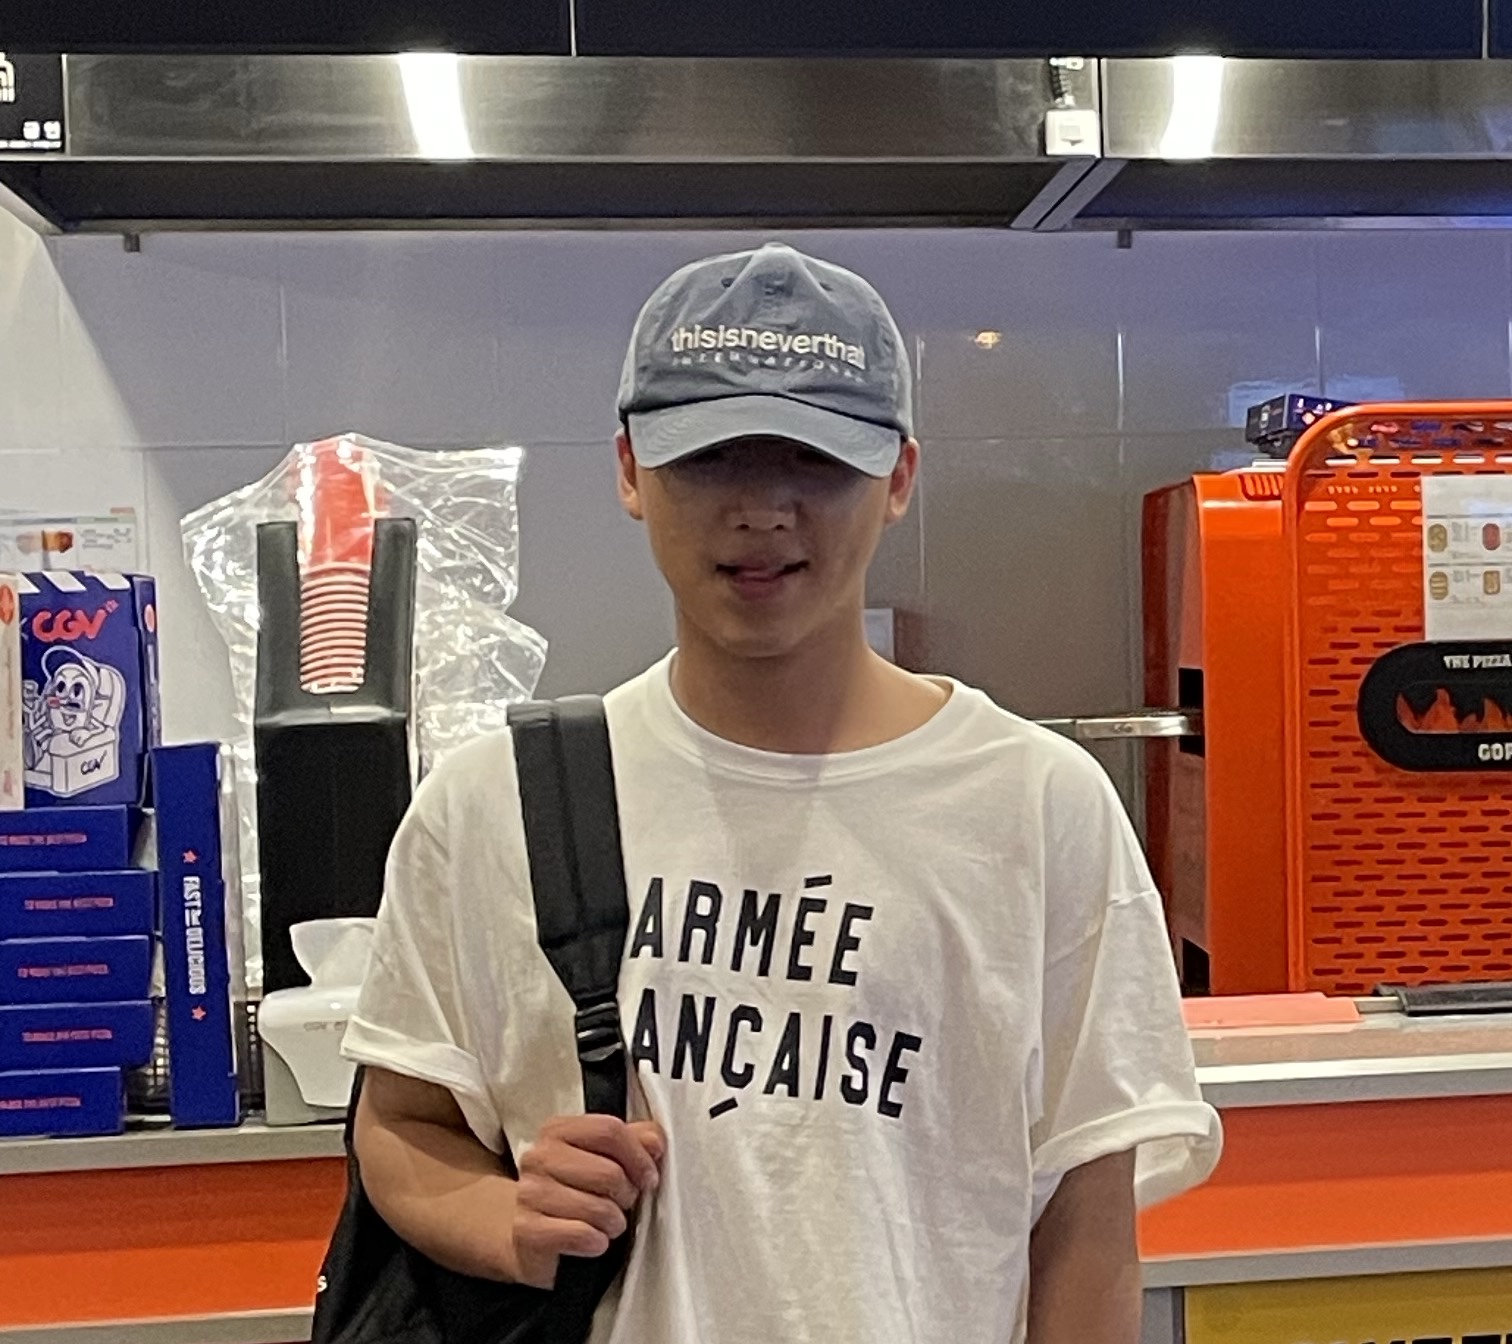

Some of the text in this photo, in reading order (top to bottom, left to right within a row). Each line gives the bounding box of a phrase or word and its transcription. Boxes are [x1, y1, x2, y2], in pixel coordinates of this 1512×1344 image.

[32, 602, 114, 642] CGV
[1443, 655, 1469, 669] THE
[1473, 654, 1512, 668] PIZZA
[183, 875, 201, 908] FAST
[629, 875, 874, 987] ARMÉE
[631, 988, 922, 1119] ANÇAISE
